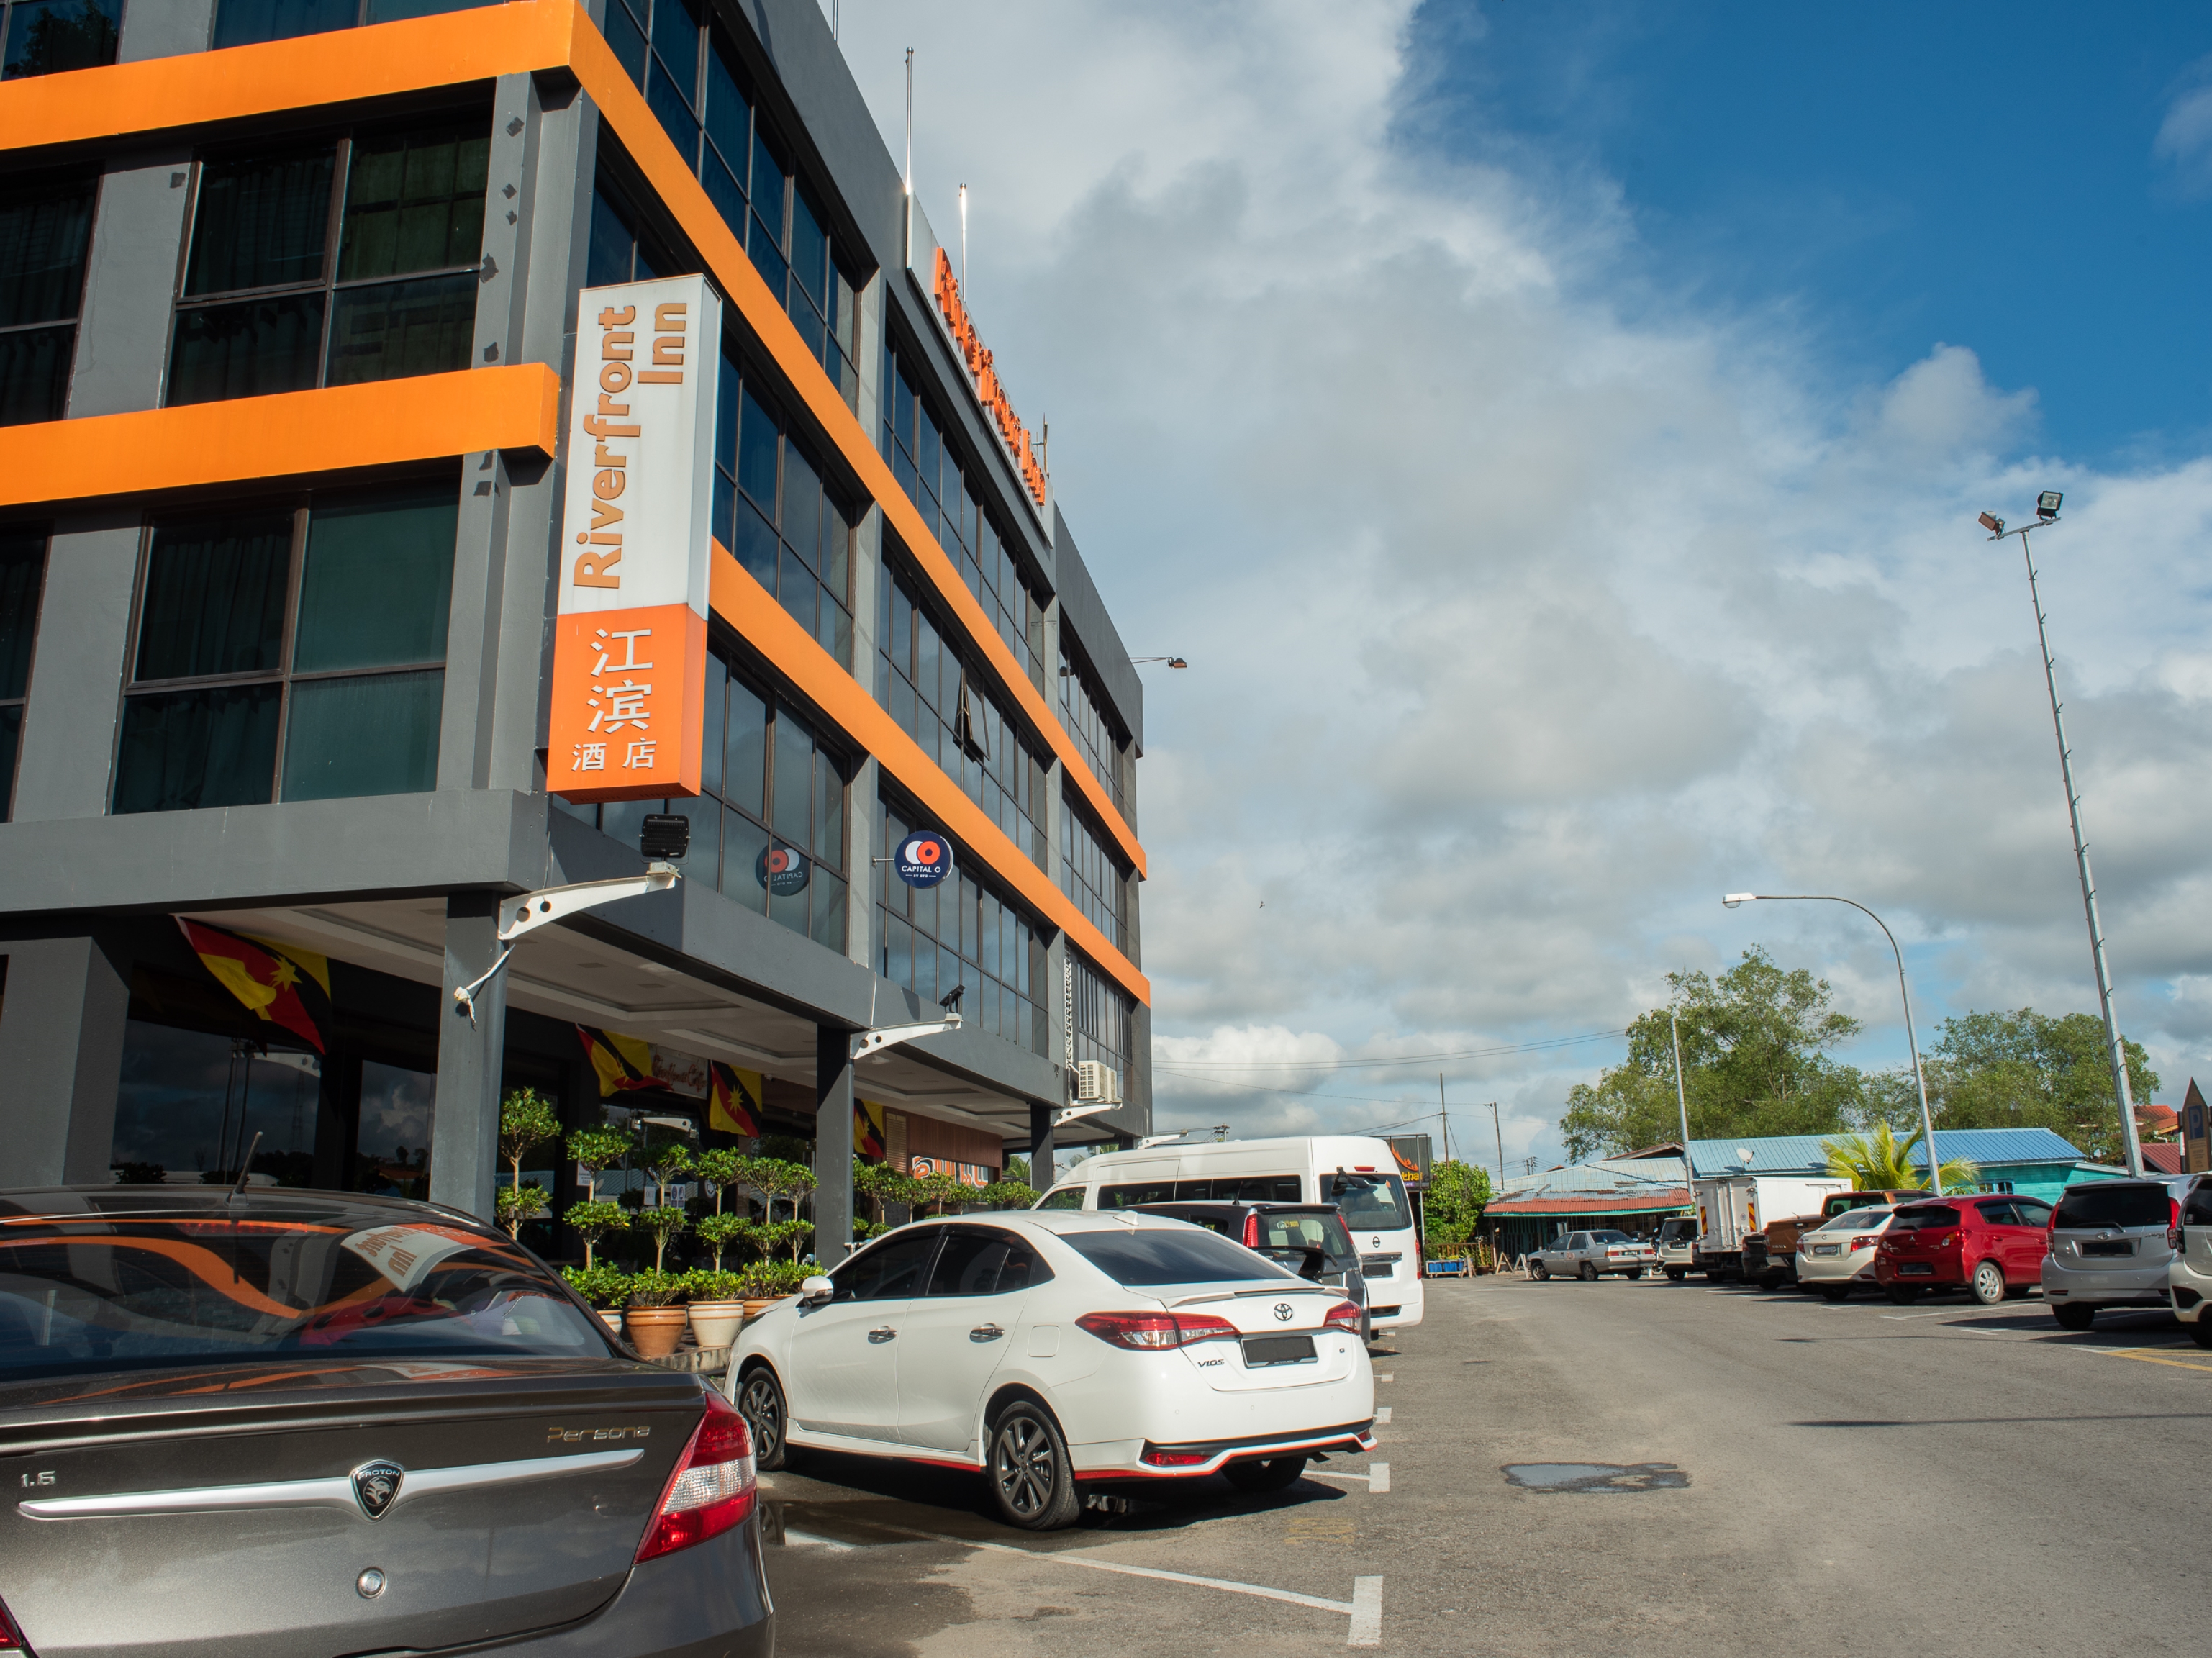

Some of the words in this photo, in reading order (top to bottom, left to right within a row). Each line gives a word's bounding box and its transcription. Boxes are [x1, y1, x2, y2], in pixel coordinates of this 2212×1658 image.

[638, 302, 688, 385] Inn
[573, 304, 642, 589] Riverfront
[586, 628, 653, 734] 江滨
[571, 737, 657, 772] 酒店
[2190, 1108, 2201, 1140] P
[1197, 1358, 1225, 1367] VIOS
[547, 1426, 651, 1444] Persona
[21, 1470, 56, 1487] 1.6
[358, 1469, 400, 1480] PROTON
